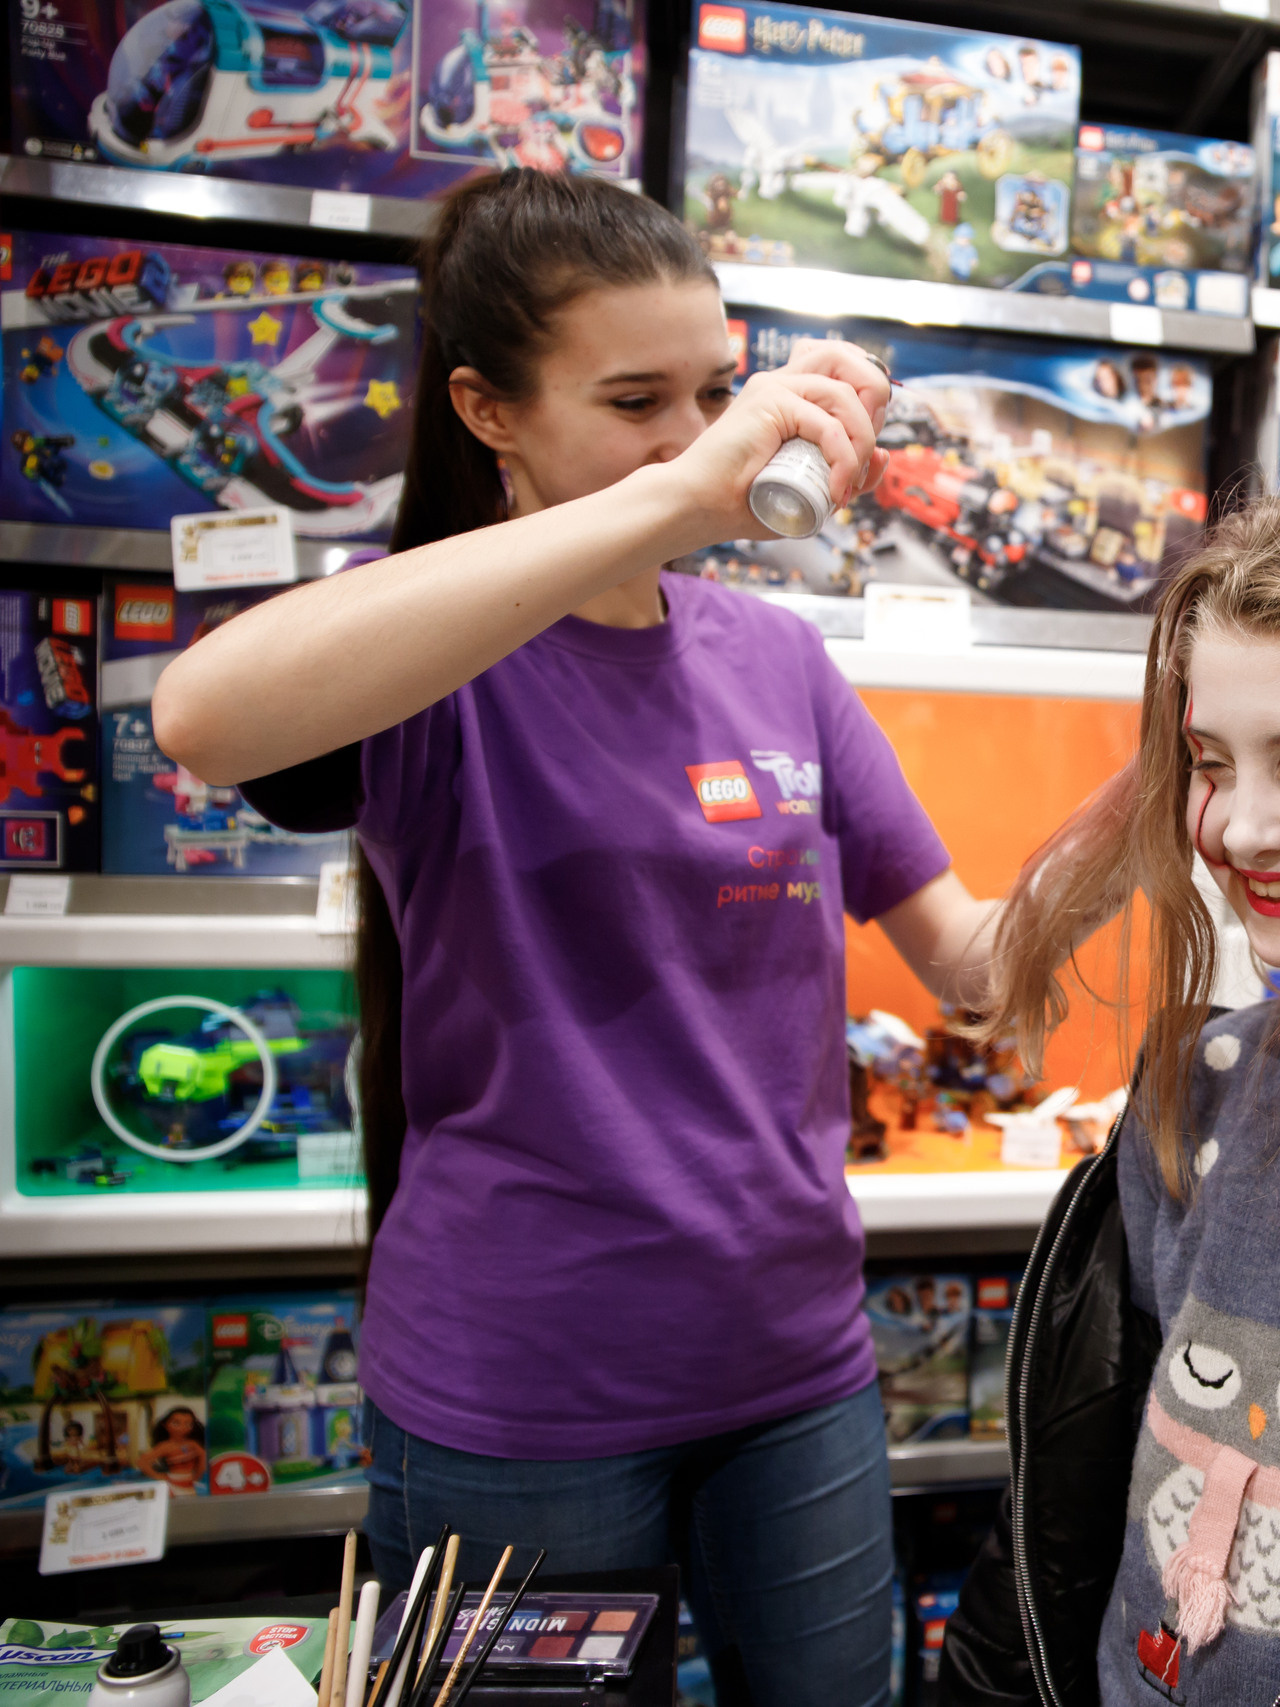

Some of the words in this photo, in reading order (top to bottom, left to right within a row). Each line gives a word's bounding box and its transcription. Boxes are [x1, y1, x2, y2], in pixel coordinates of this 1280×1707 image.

[26, 250, 142, 298] LEGO
[117, 600, 170, 625] LEGO
[112, 712, 146, 737] 7+
[700, 777, 748, 803] LEGO
[215, 1461, 265, 1492] 4+
[258, 1633, 298, 1641] BACTERIA
